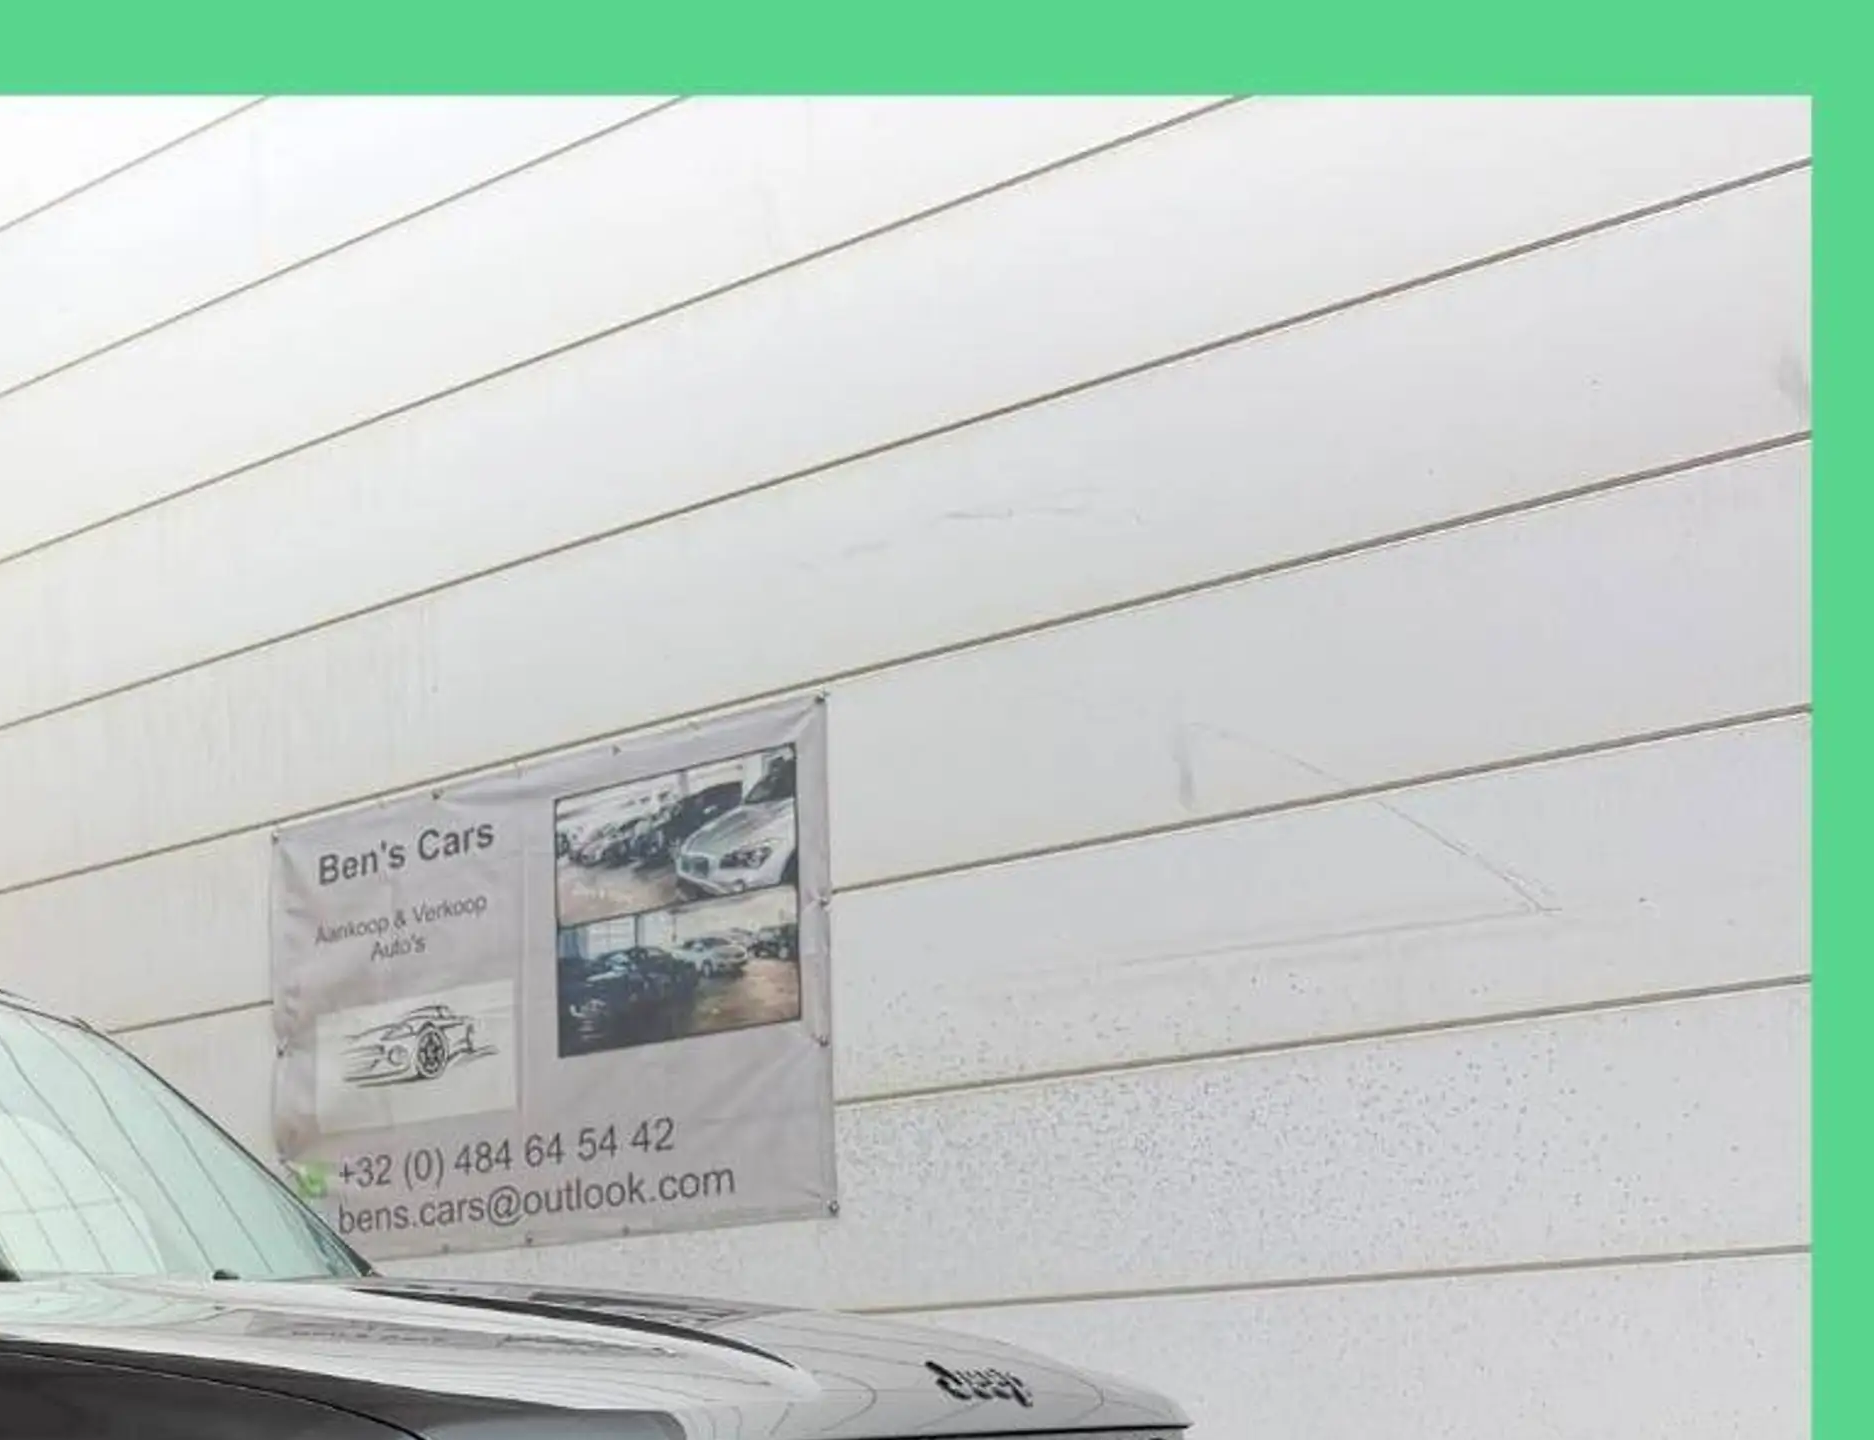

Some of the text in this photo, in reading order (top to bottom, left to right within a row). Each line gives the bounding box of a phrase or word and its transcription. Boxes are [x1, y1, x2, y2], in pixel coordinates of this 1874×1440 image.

[318, 823, 495, 886] Ben's Cars
[315, 895, 488, 945] Aankoop & Verkoop
[370, 933, 427, 962] Auto's
[338, 1116, 675, 1191] +32 (0) 484 64 54 42
[338, 1167, 737, 1235] bens.cars@outlook.com
